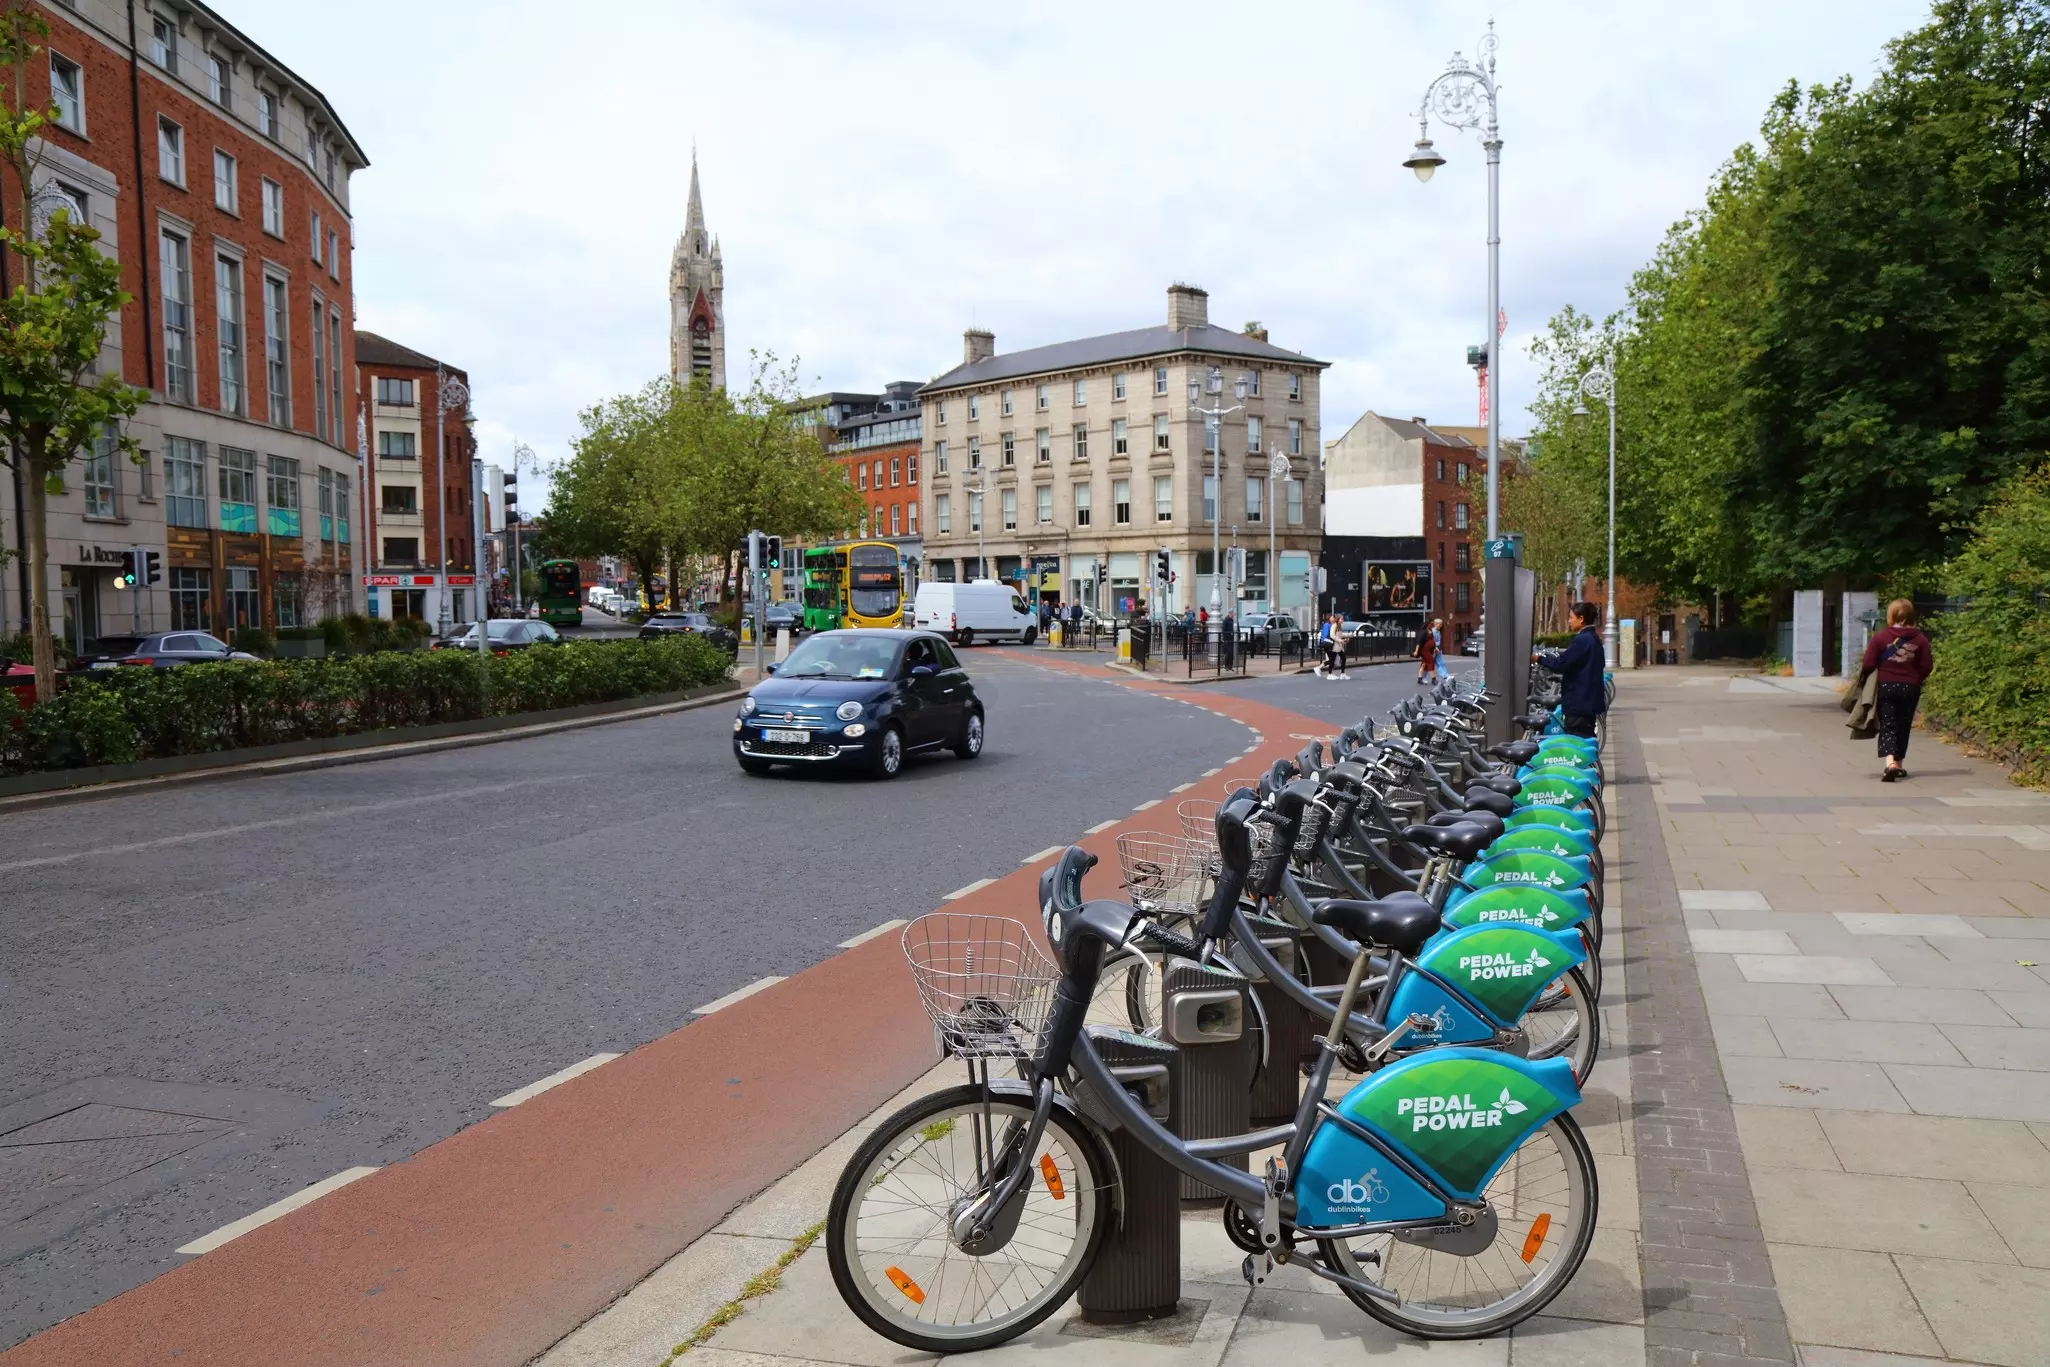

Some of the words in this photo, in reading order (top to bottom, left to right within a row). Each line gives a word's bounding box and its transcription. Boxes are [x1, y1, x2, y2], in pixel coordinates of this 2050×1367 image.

[1543, 756, 1567, 764] PEDAL
[1527, 792, 1556, 801] PEDAL
[1494, 871, 1538, 882] PEDAL
[1479, 908, 1528, 922] PEDAL
[1459, 952, 1515, 969] PEDAL
[1470, 963, 1534, 981] POWER
[1397, 1093, 1477, 1115] PEDAL
[1412, 1109, 1502, 1132] POWER
[1327, 1205, 1371, 1213] dublinbikes
[1434, 1226, 1462, 1235] 02245
